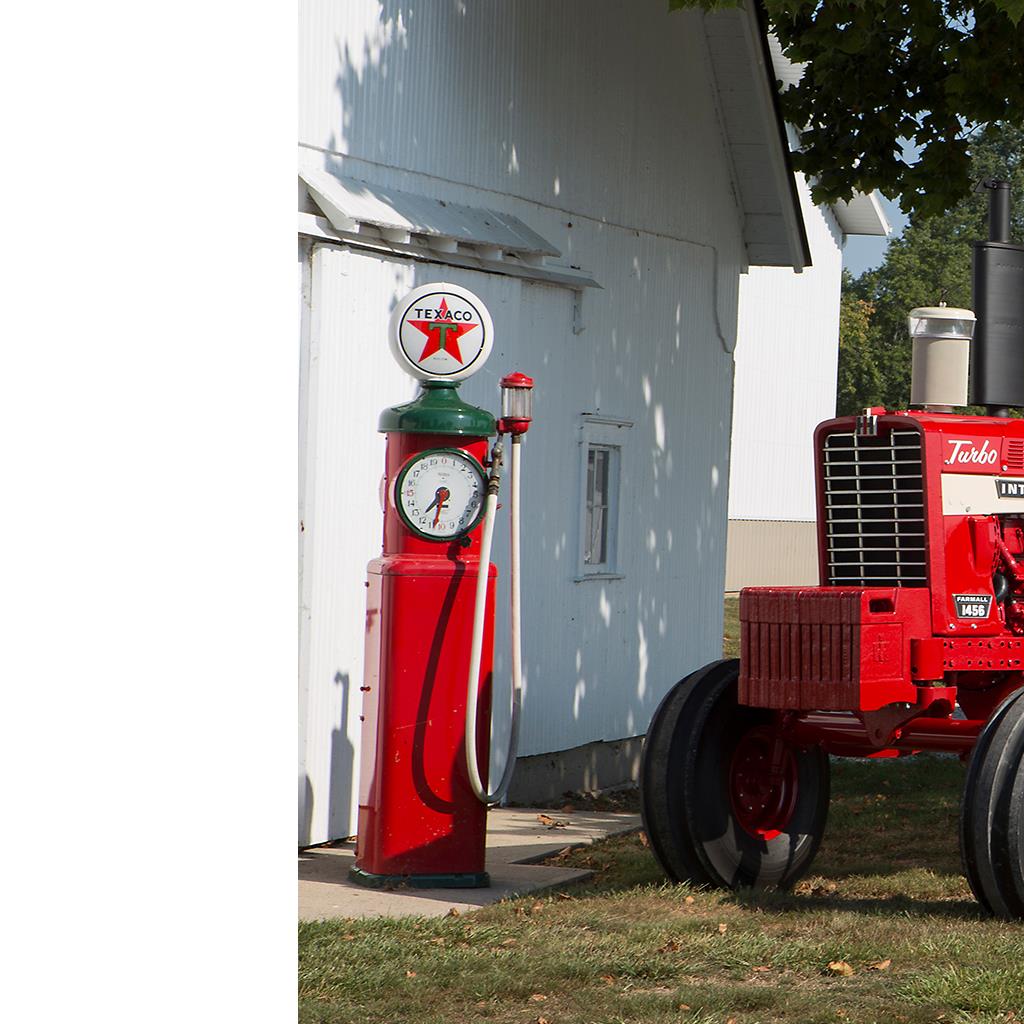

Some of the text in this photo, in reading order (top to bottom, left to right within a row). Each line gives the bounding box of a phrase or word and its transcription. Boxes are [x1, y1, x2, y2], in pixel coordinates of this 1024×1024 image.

[415, 308, 472, 321] TEXACO
[429, 322, 458, 349] T
[945, 440, 998, 464] Turbo
[961, 604, 985, 616] 1456
